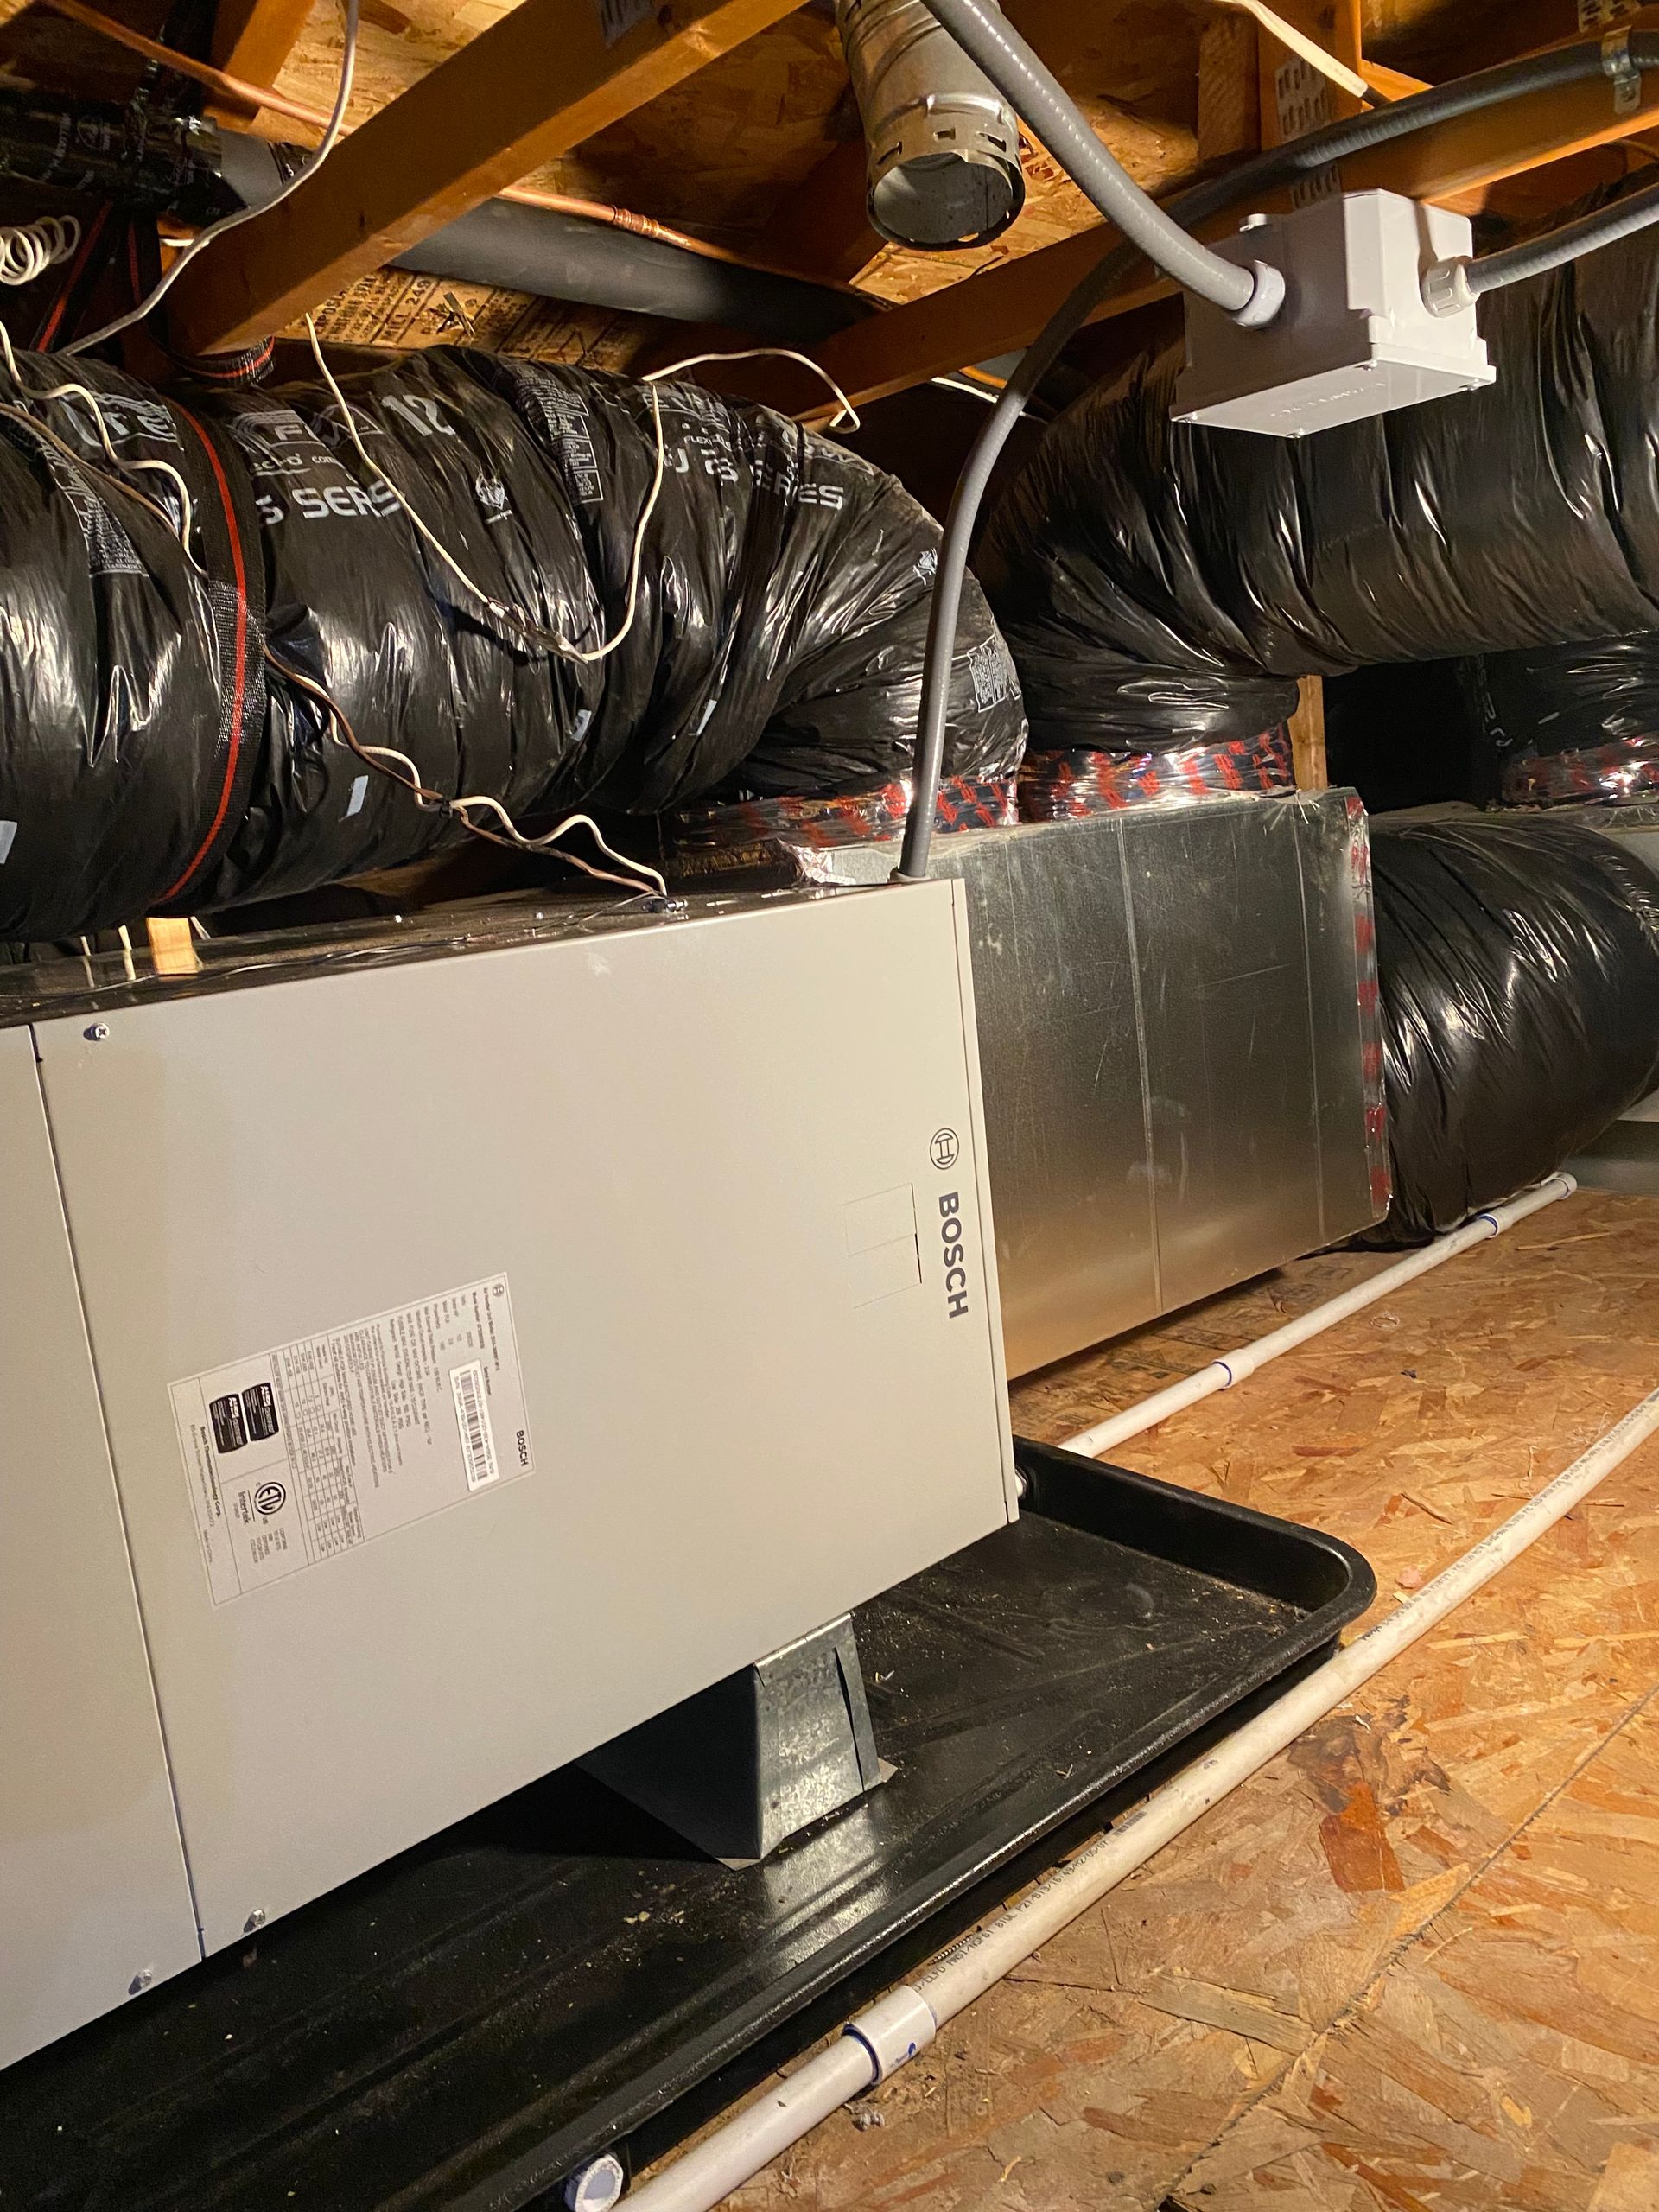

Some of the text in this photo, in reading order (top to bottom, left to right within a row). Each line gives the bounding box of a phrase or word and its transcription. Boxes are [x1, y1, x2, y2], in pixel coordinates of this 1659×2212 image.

[405, 278, 433, 306] 249
[381, 394, 456, 437] 12
[938, 1191, 969, 1319] BOSCH
[516, 1429, 529, 1467] BOSCH
[238, 1490, 251, 1524] Intertek
